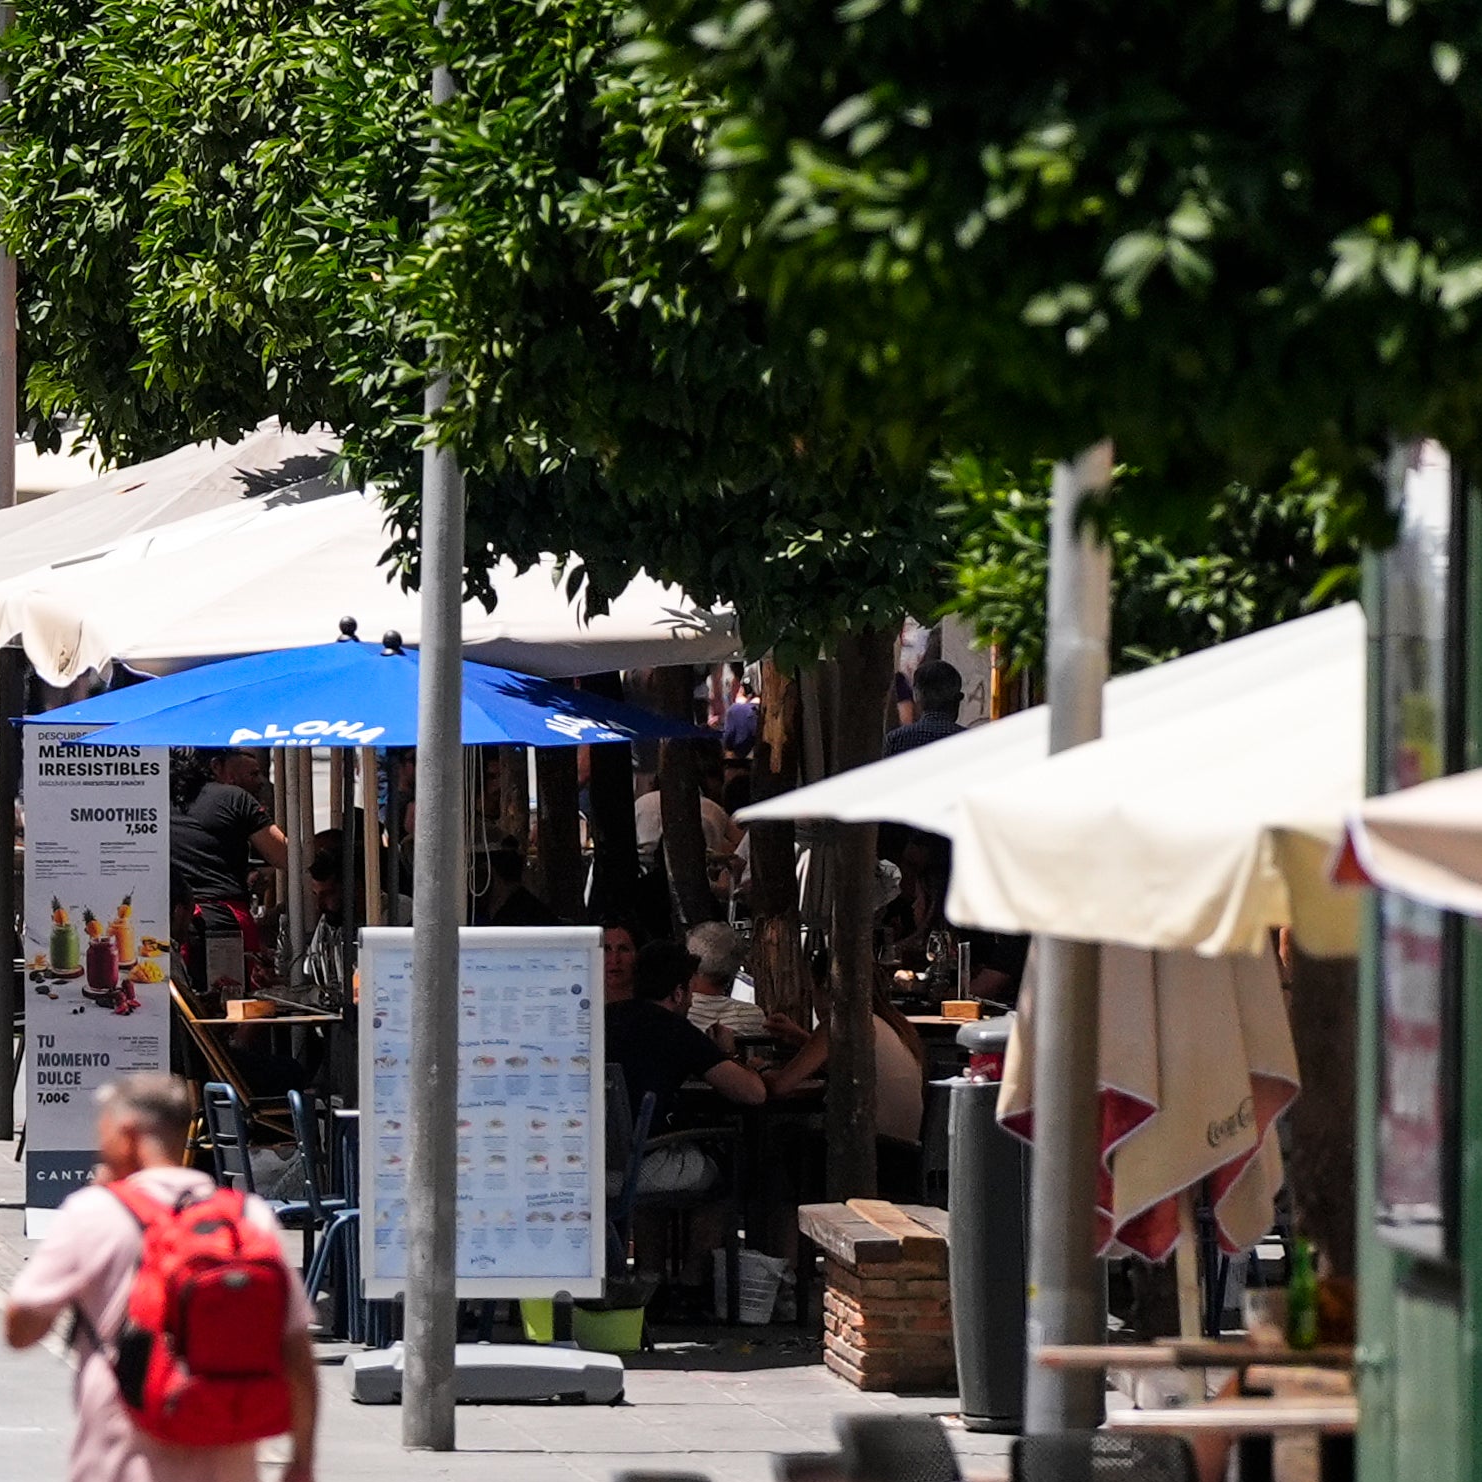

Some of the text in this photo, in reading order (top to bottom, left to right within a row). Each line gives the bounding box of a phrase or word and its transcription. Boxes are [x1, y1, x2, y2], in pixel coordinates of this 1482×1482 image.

[229, 720, 385, 745] ALOHA
[39, 745, 141, 758] MERIENDAS
[38, 762, 160, 776] IRRESISTIBLES
[70, 808, 157, 822] SMOOTHIES
[125, 823, 158, 836] 7,50€
[37, 1034, 55, 1048] TU
[37, 1053, 110, 1067] MOMENTO
[37, 1071, 81, 1085] DULCE
[37, 1093, 70, 1105] 7,00€
[36, 1170, 96, 1181] CANTA
